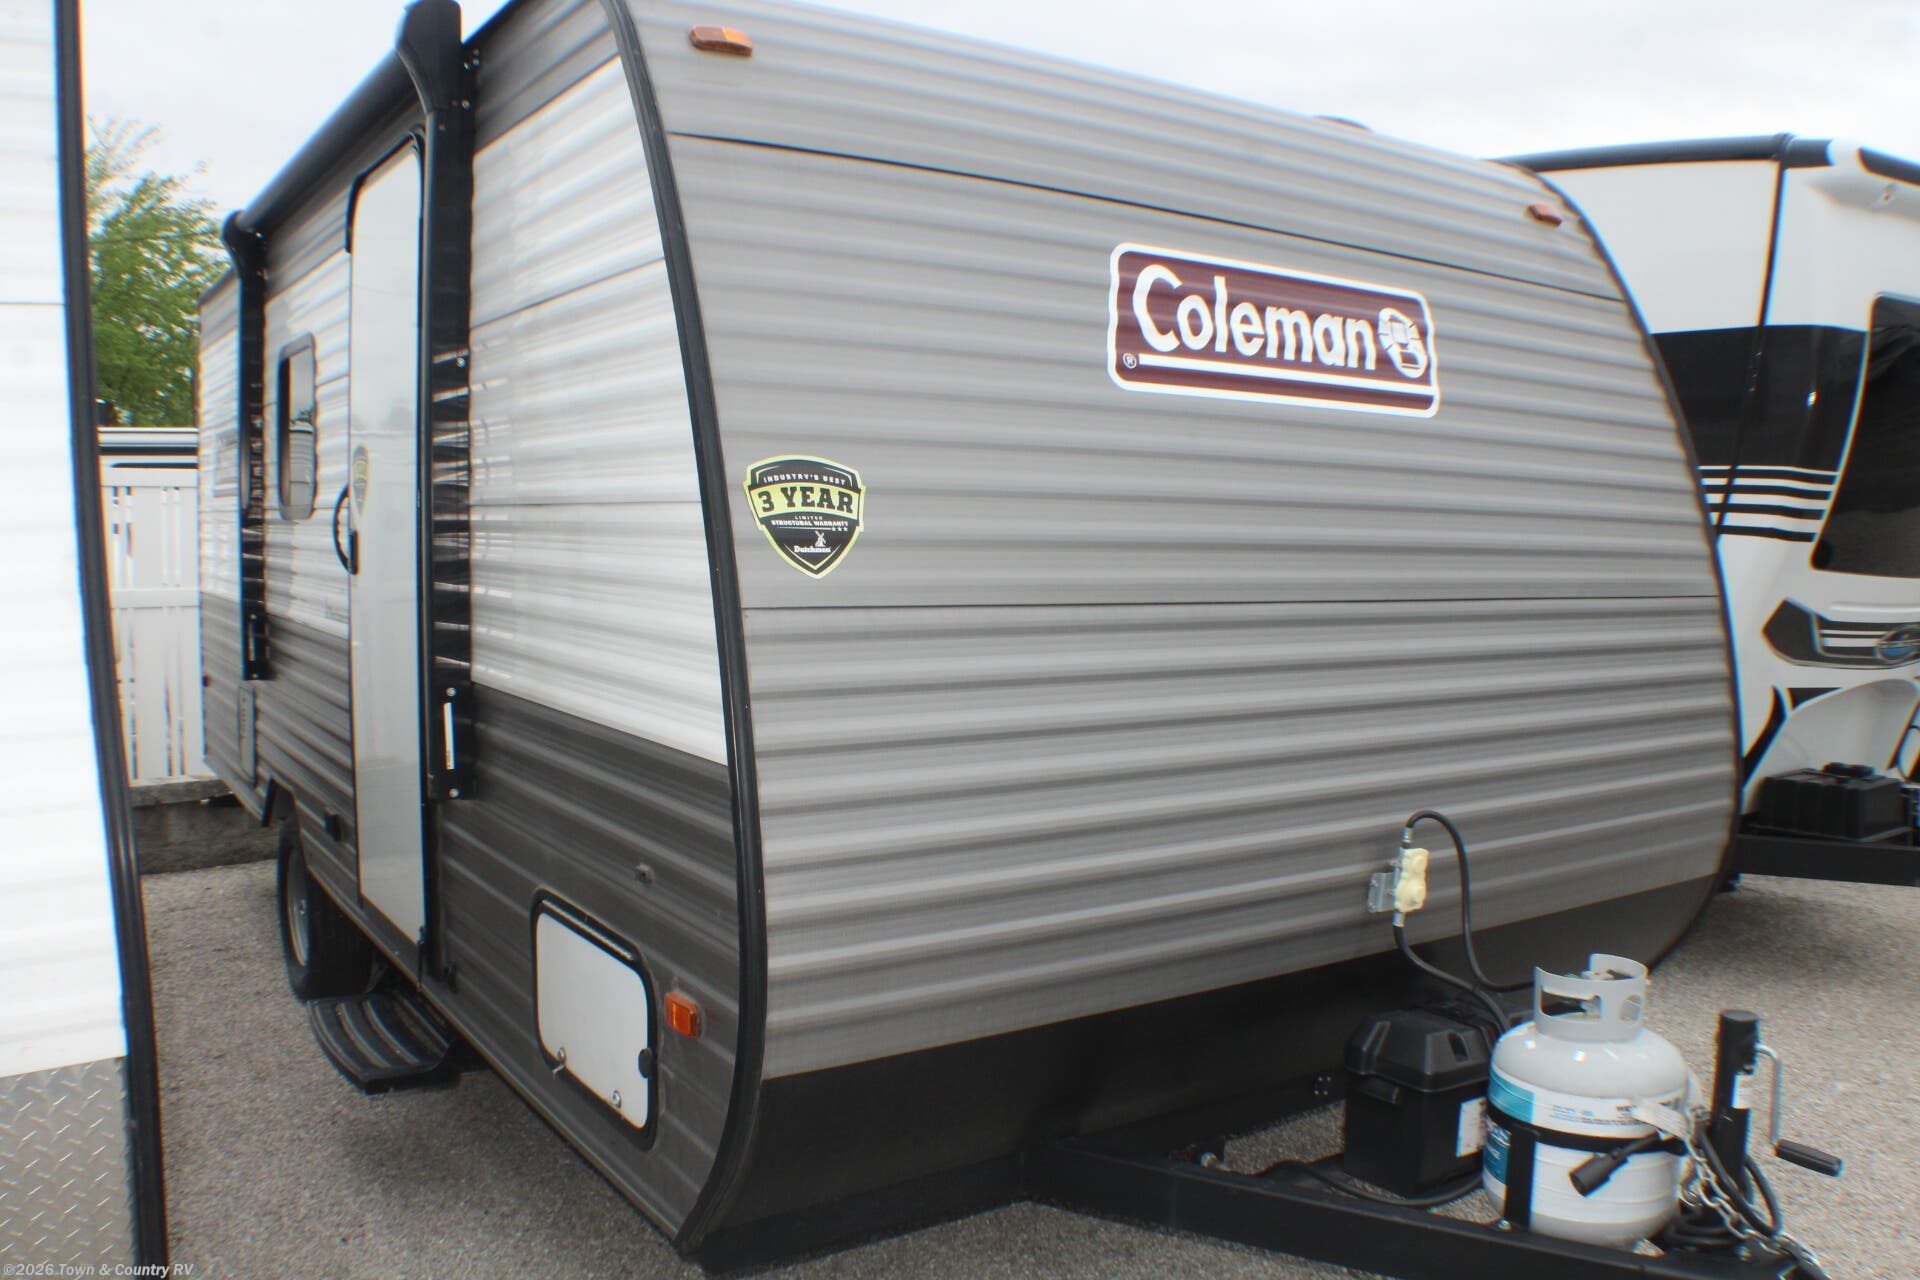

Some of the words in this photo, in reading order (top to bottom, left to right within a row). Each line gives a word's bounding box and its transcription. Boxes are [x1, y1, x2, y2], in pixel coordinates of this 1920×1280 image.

[1132, 264, 1377, 370] Coleman
[763, 473, 819, 484] INDUSTRY'S
[822, 475, 846, 485] BEST
[757, 490, 775, 513] 3
[780, 486, 854, 514] YEAR
